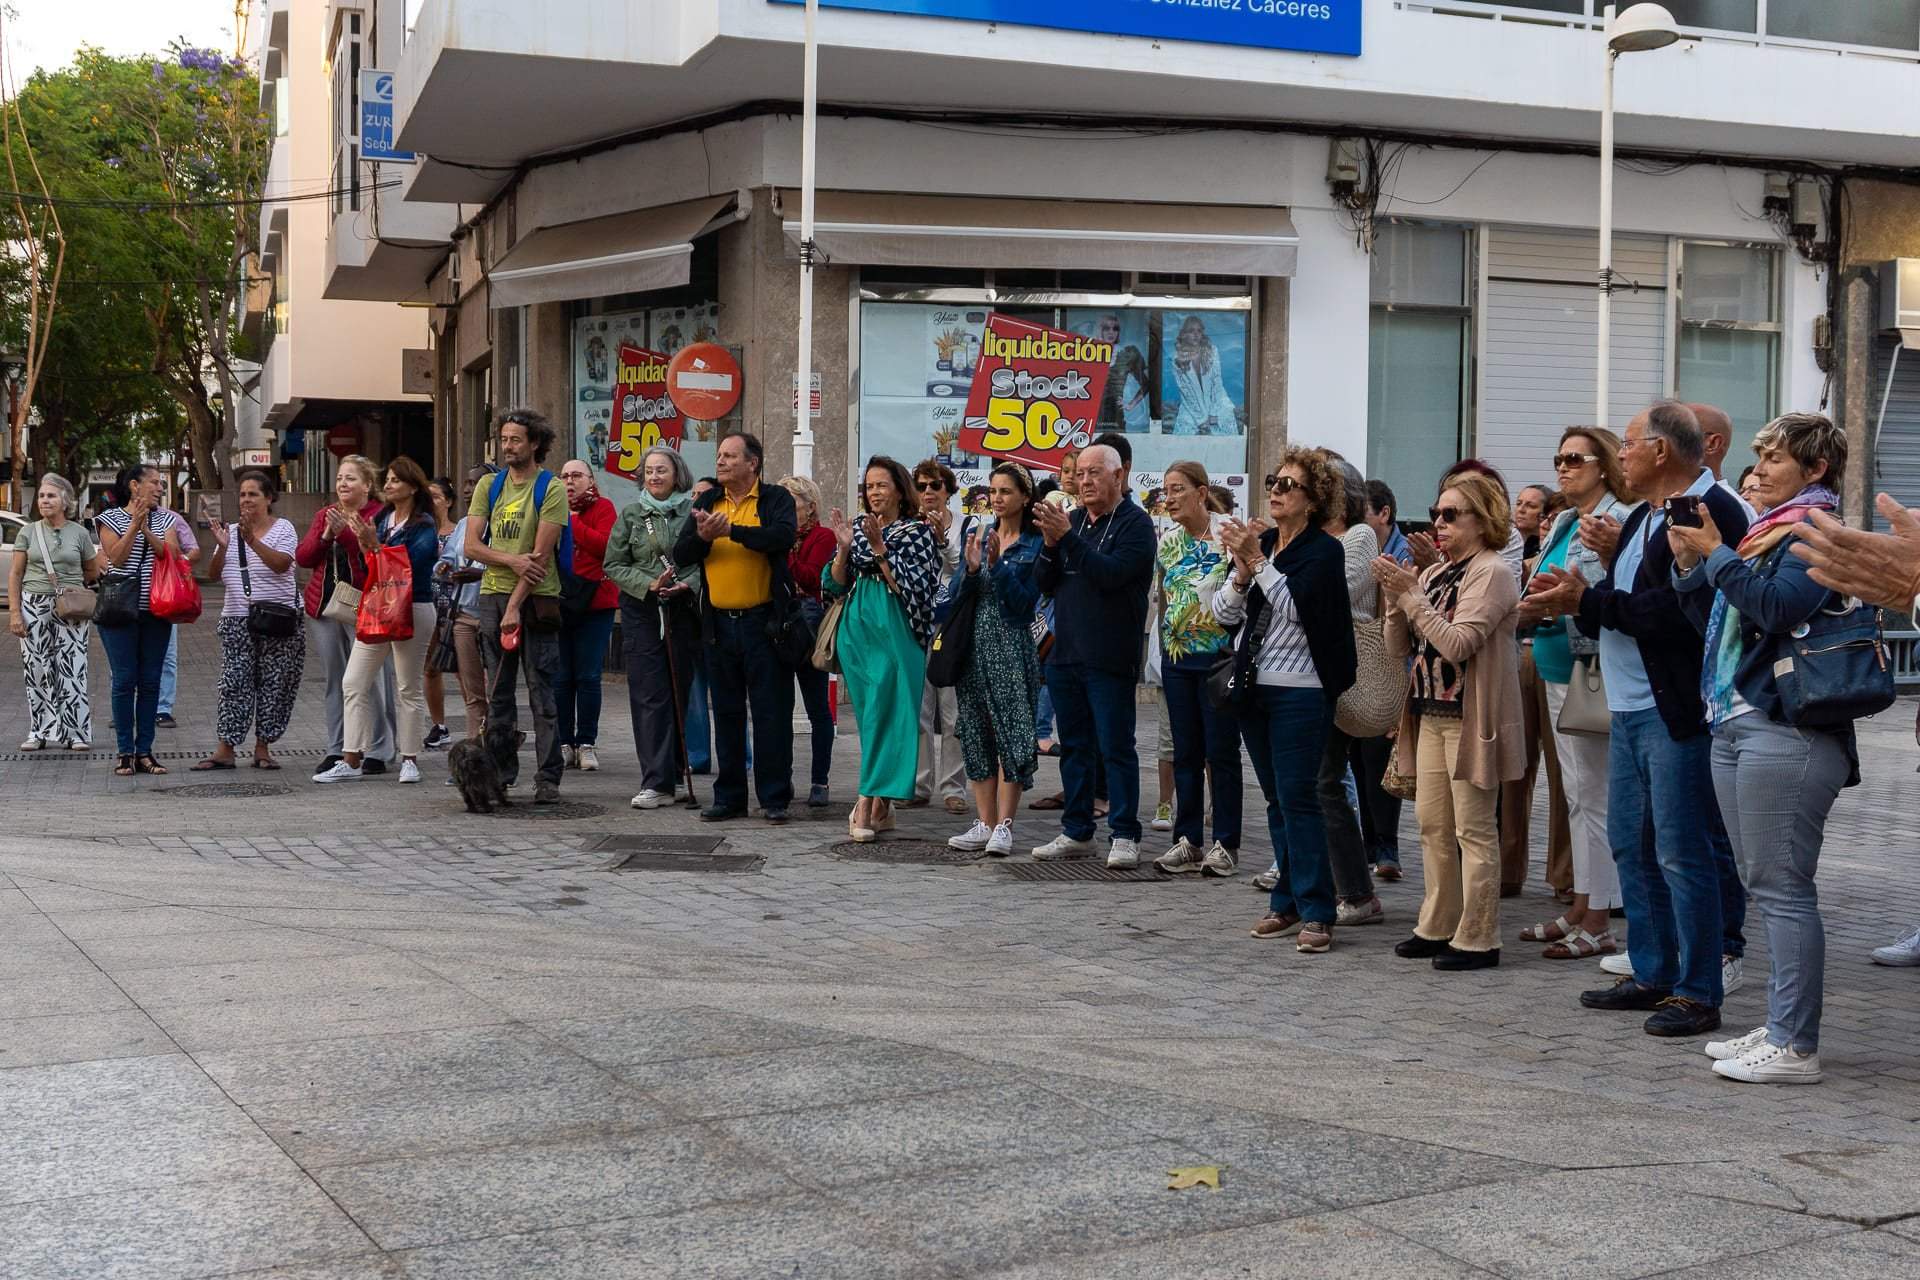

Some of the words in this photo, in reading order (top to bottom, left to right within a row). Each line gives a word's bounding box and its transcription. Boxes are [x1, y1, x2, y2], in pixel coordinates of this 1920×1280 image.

[983, 327, 1112, 366] liquidación
[618, 356, 672, 391] liquidac
[992, 368, 1090, 399] Stock
[623, 392, 678, 421] Stock
[965, 397, 1090, 450] -50%
[251, 454, 271, 463] OUT
